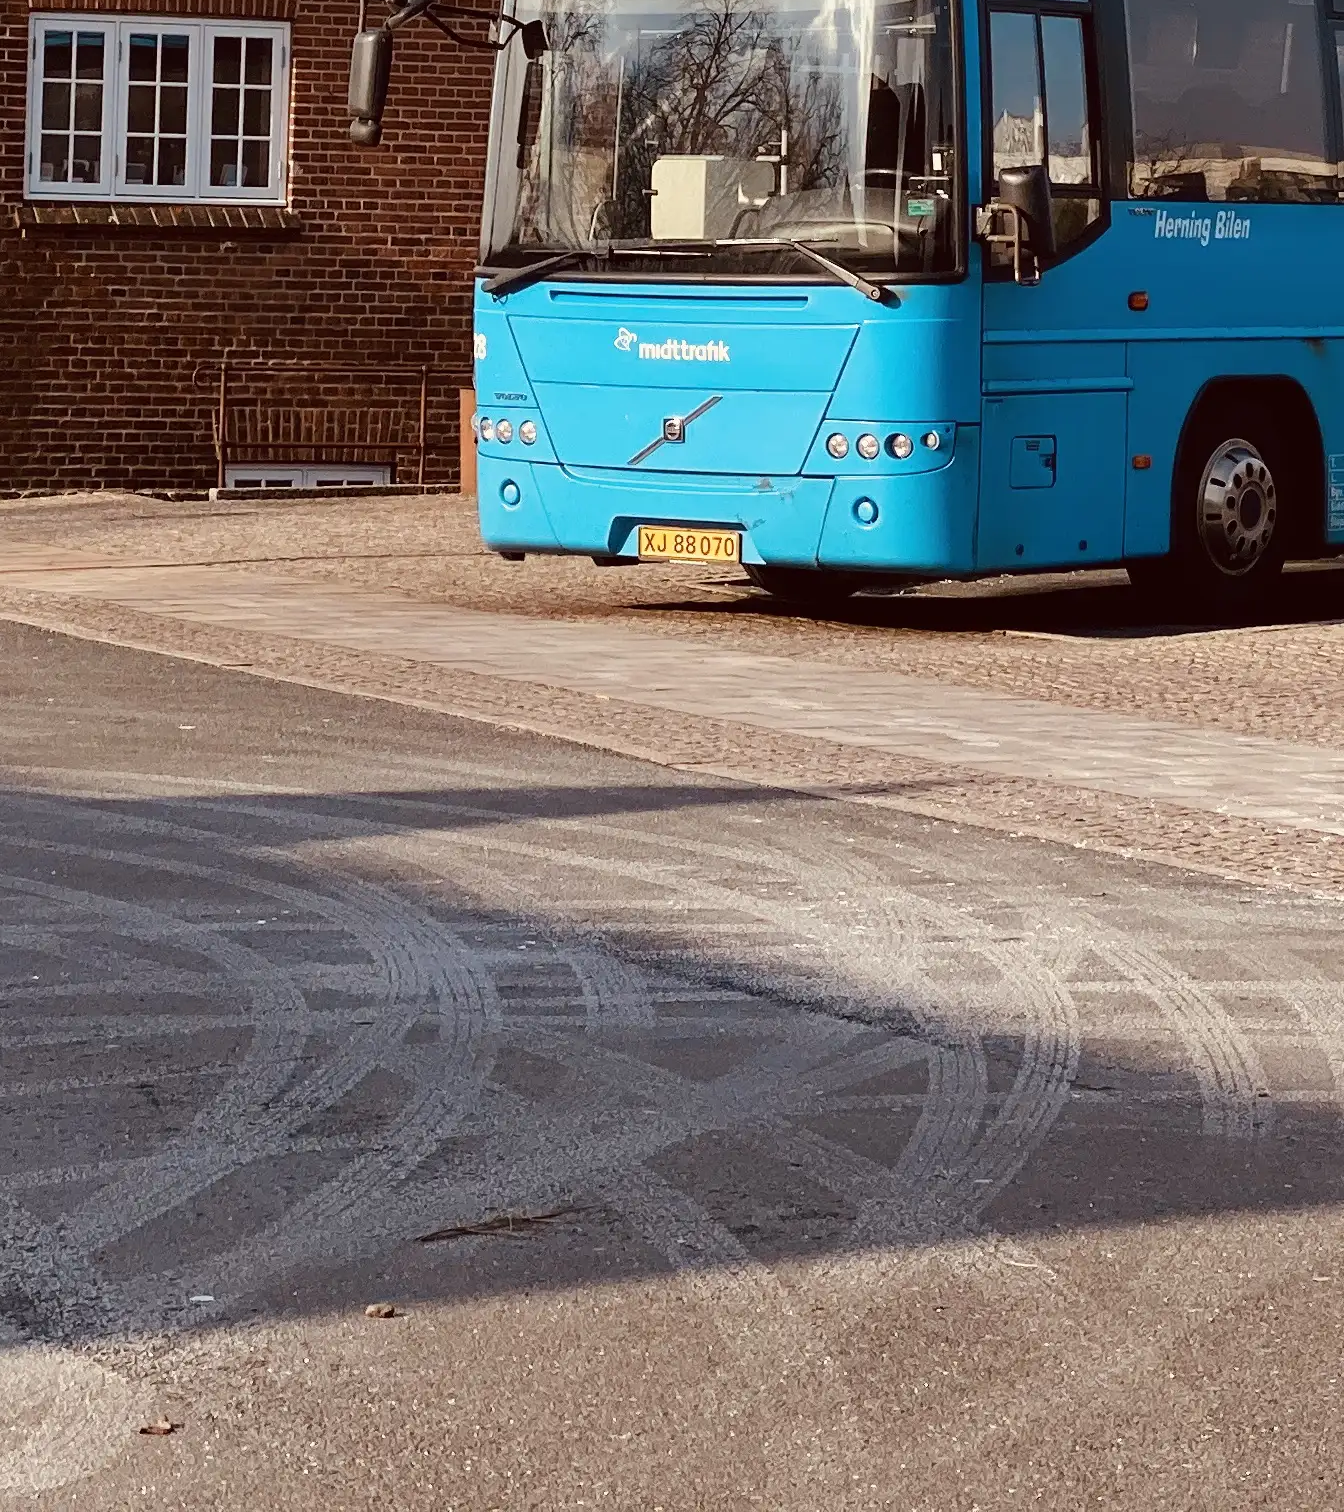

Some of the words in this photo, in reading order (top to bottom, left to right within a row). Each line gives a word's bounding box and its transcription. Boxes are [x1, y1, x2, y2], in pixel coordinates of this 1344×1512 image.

[1154, 210, 1211, 246] Herning
[1215, 210, 1250, 239] Bilen
[639, 338, 731, 361] midttrafik
[645, 533, 667, 552] XJ
